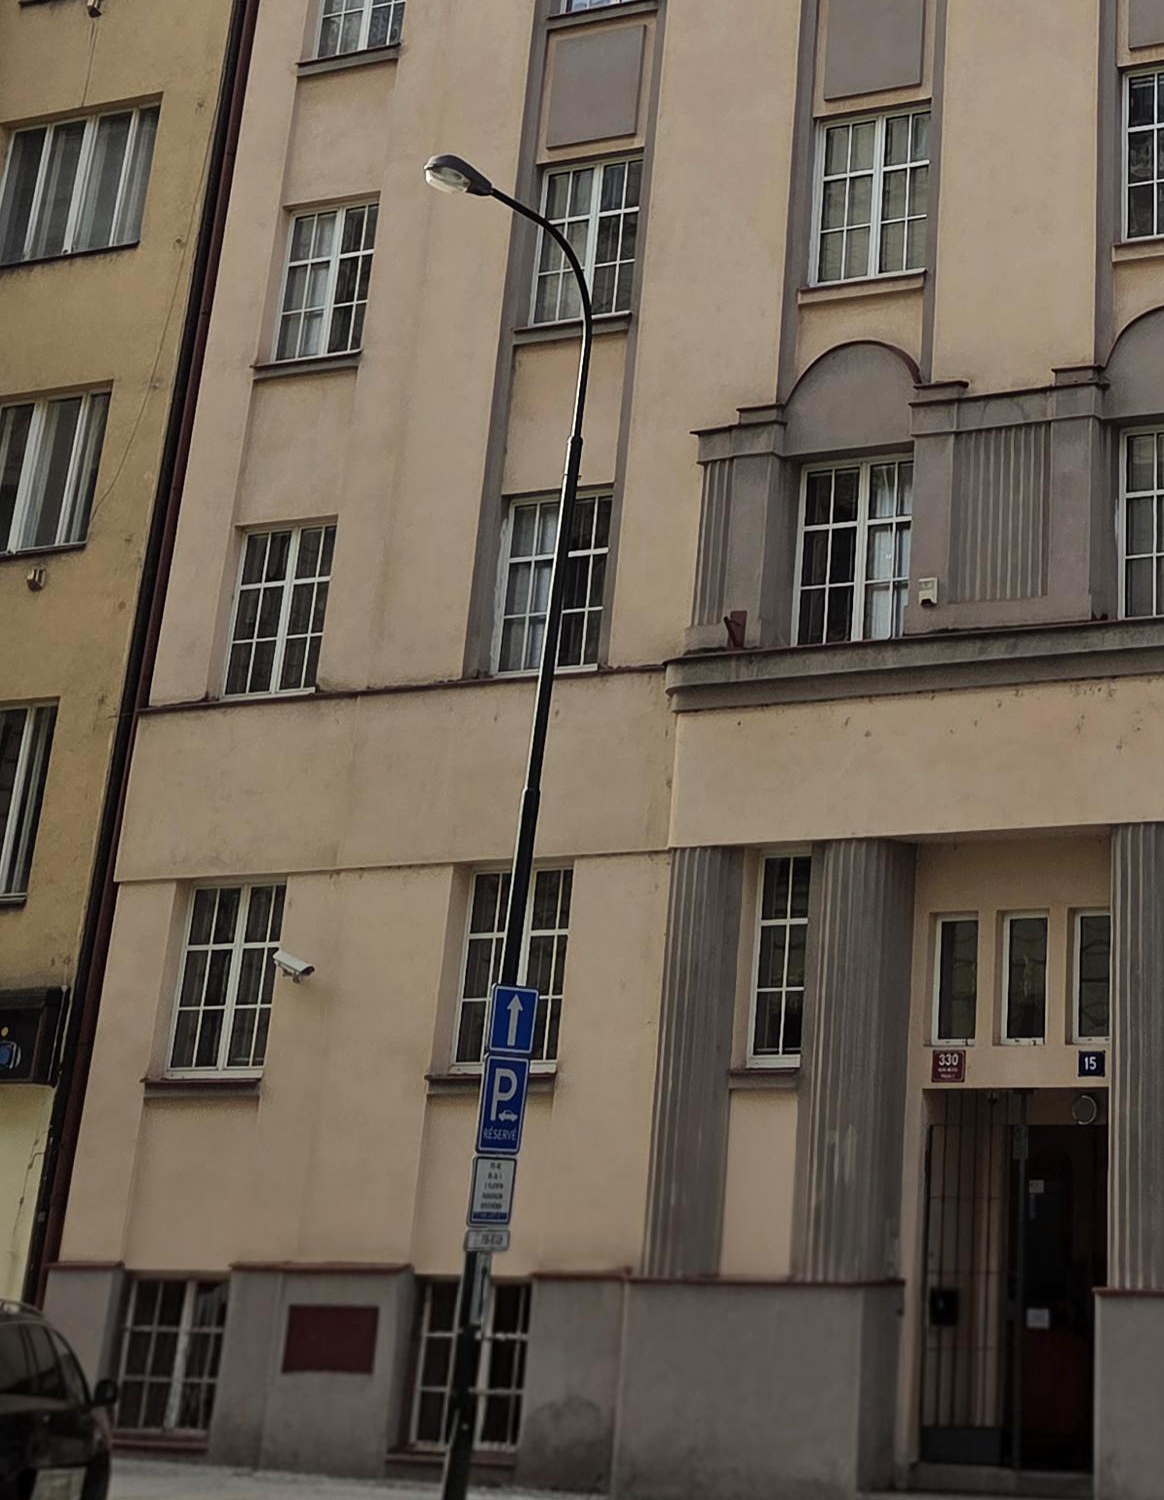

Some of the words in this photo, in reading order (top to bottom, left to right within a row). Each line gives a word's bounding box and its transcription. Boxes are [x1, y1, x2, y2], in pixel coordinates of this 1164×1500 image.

[938, 1053, 959, 1066] 330
[1084, 1056, 1097, 1070] 15
[490, 1068, 518, 1121] P
